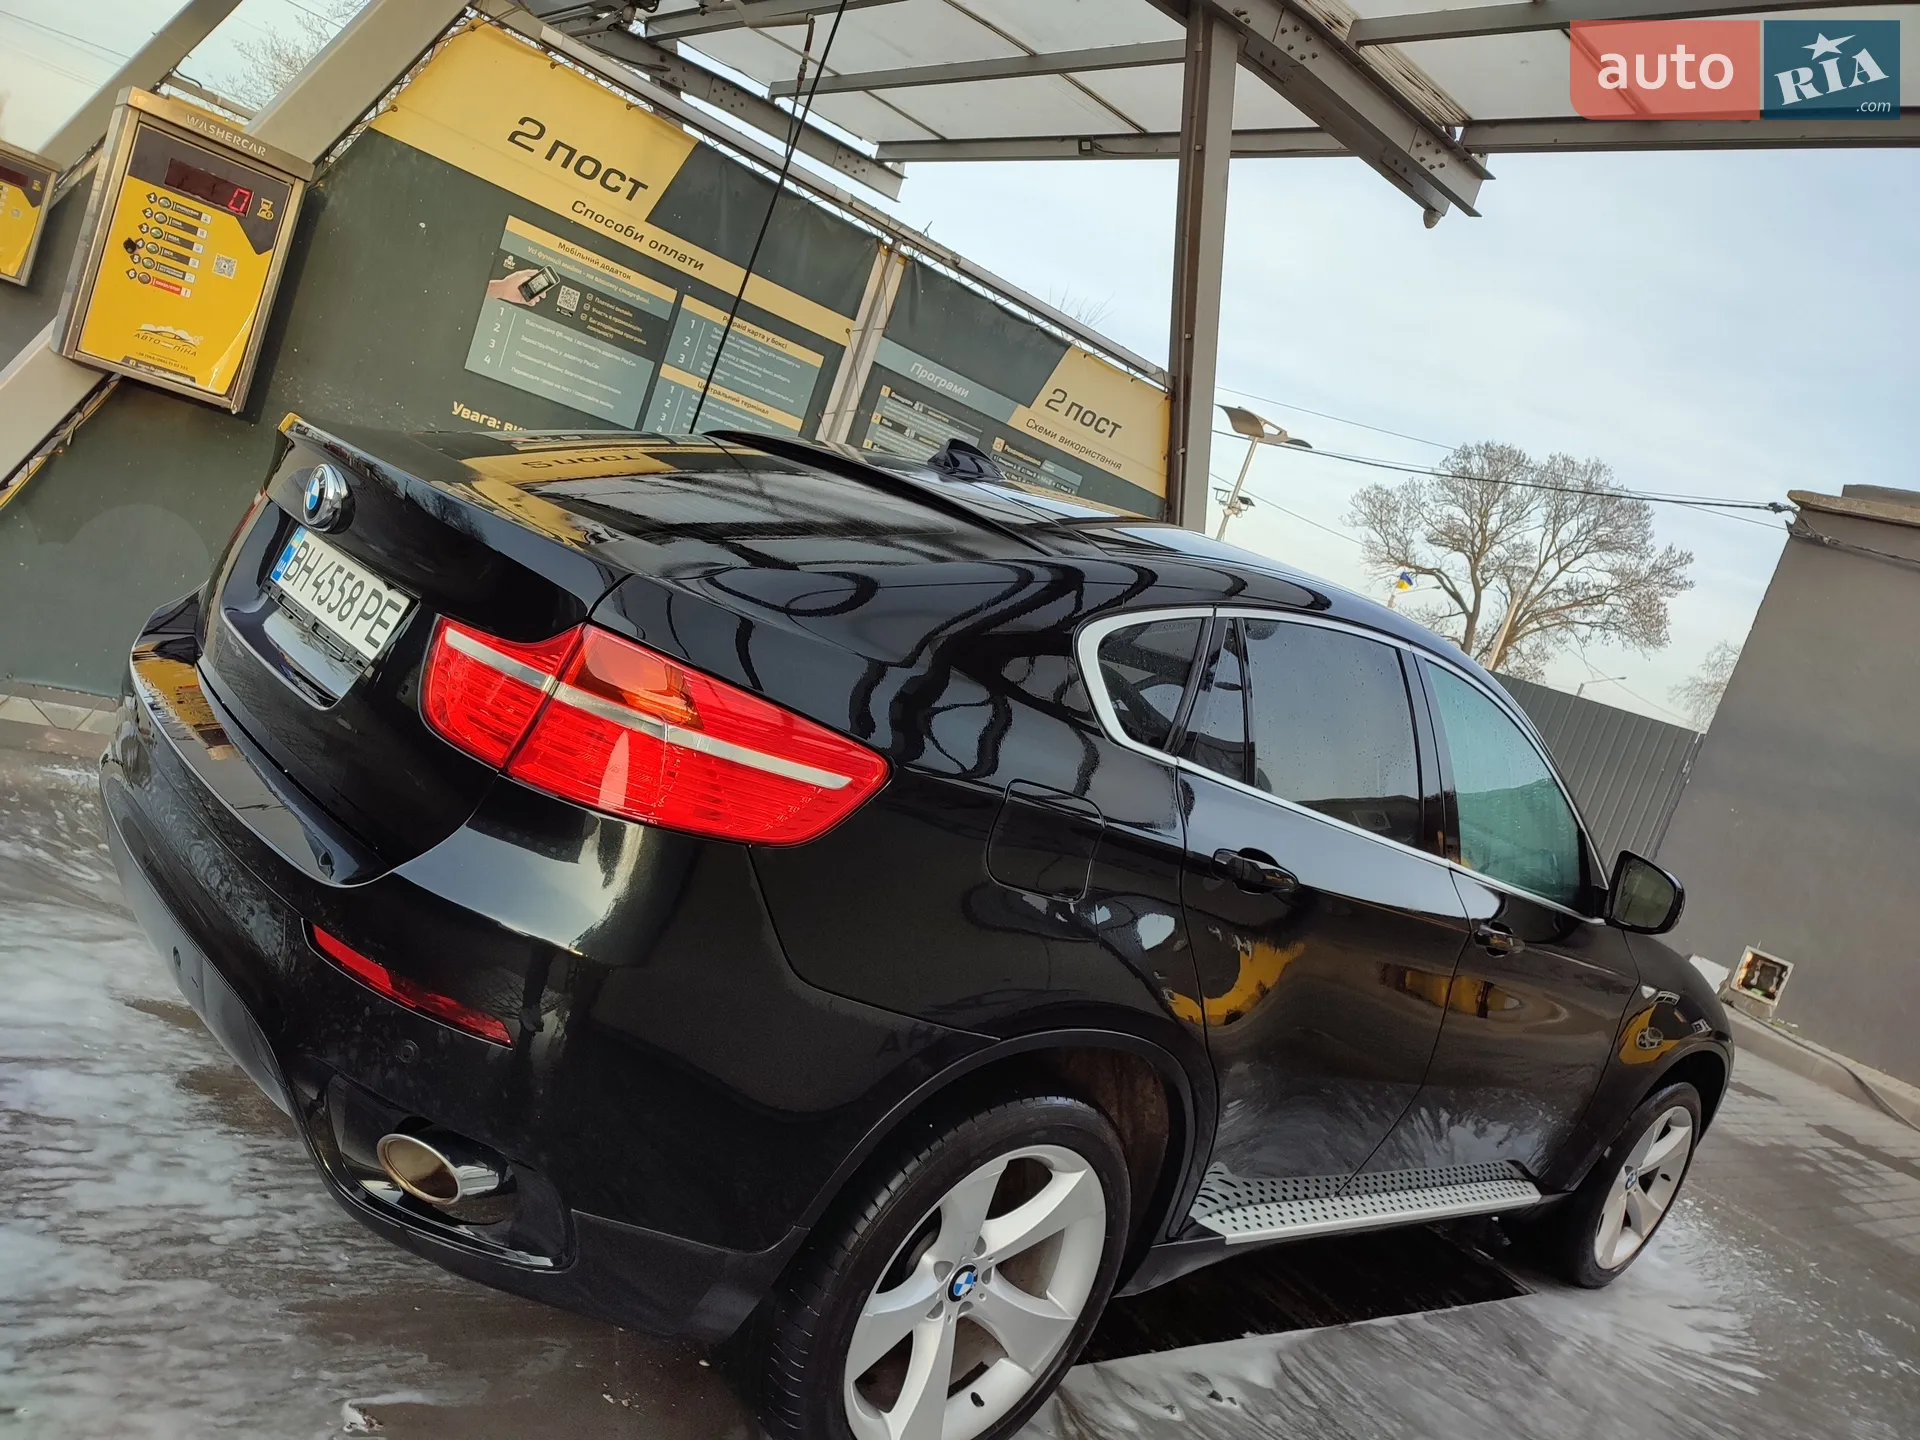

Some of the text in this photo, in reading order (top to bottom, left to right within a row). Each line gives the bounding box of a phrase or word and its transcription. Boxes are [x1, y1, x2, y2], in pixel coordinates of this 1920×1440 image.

[186, 114, 266, 156] WASHERCAR
[507, 116, 649, 202] 2 пост
[571, 200, 705, 273] Способи оплати
[556, 241, 632, 280] Мобільний додаток
[497, 307, 505, 316] 1
[492, 322, 501, 333] 2
[690, 320, 695, 328] 1
[133, 333, 160, 345] АВТО
[172, 346, 197, 357] ПІНА
[487, 338, 496, 349] 3
[684, 337, 690, 346] 2
[747, 328, 766, 341] карта
[771, 337, 787, 349] боксі
[482, 354, 492, 364] 4
[678, 354, 685, 363] 3
[909, 361, 968, 398] Програми
[670, 386, 674, 394] 1
[452, 401, 501, 429] Увага:
[741, 398, 769, 415] термінал
[1045, 388, 1122, 439] 2 пост
[660, 413, 666, 421] 3
[1026, 418, 1122, 470] Схеми використання
[276, 559, 286, 572] UA
